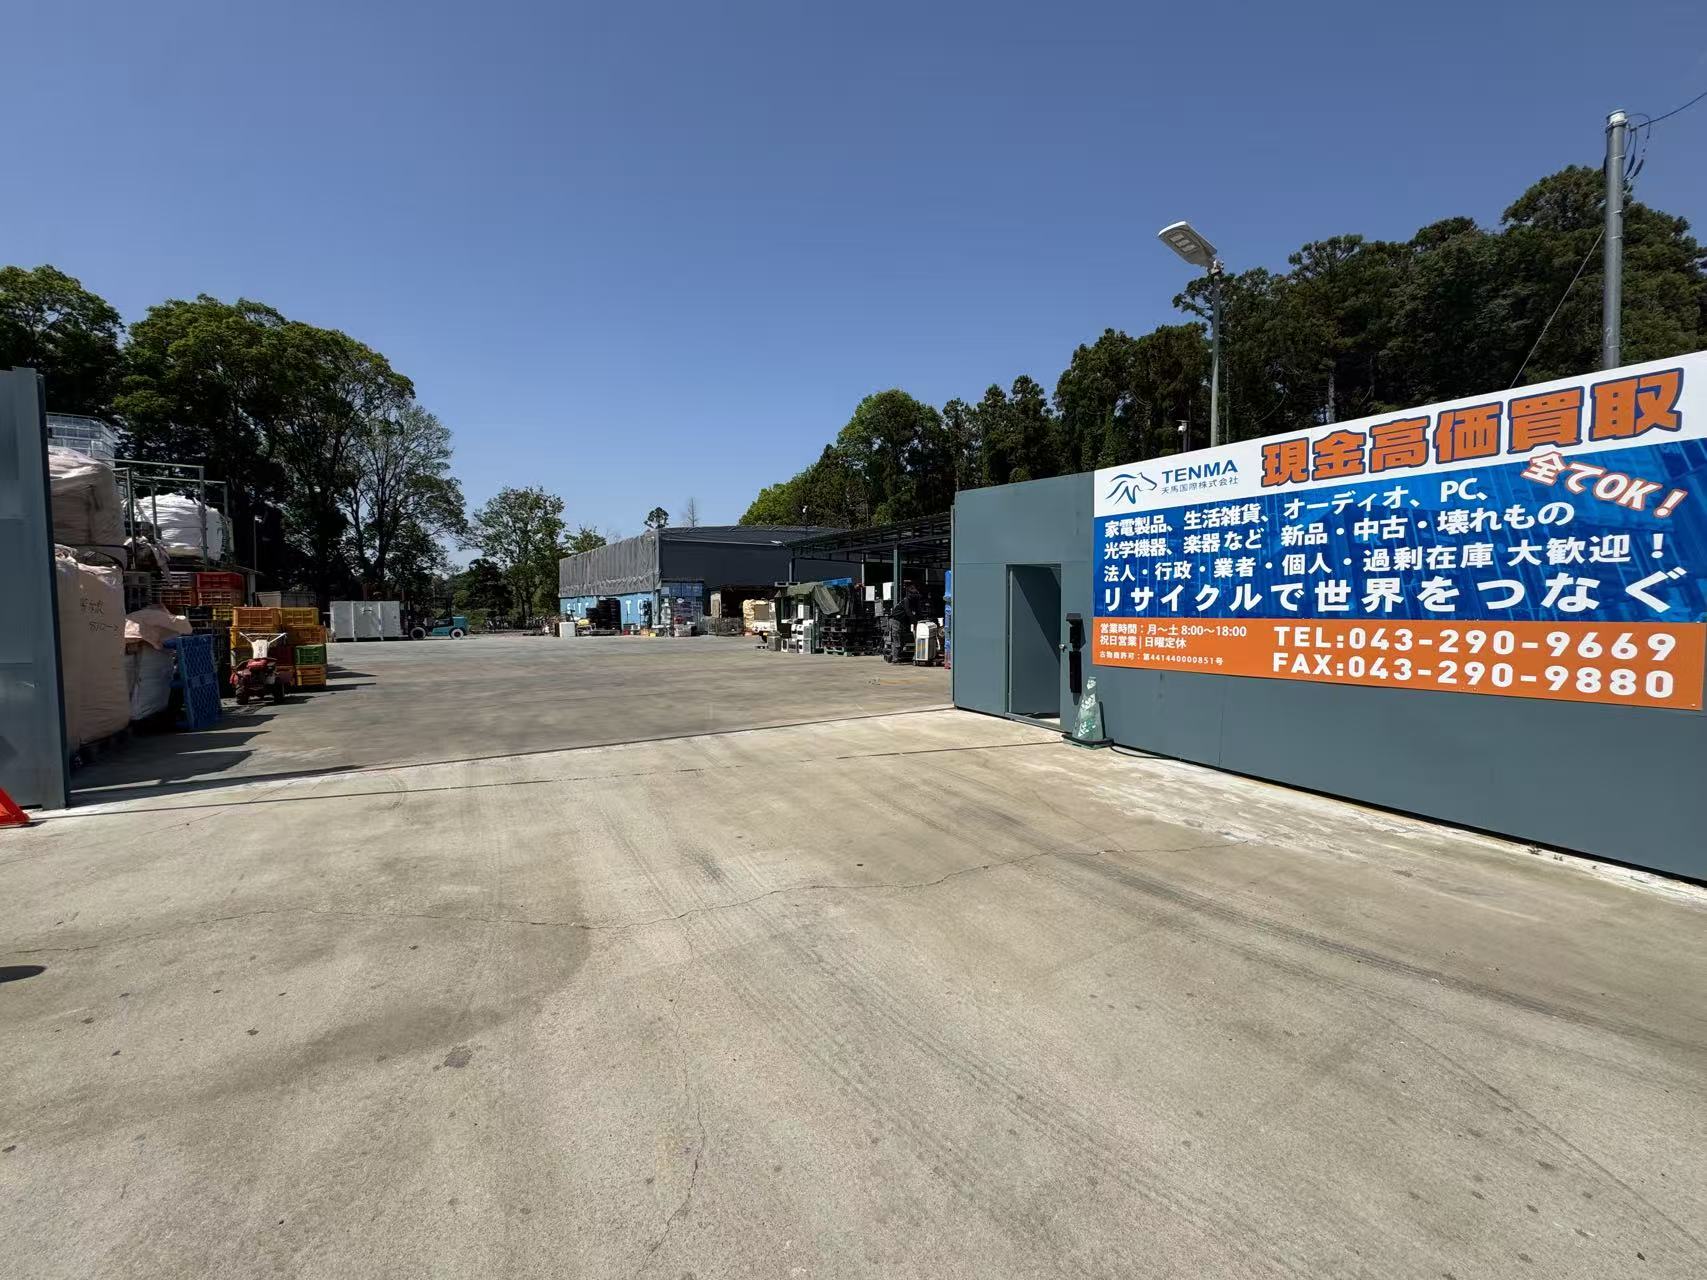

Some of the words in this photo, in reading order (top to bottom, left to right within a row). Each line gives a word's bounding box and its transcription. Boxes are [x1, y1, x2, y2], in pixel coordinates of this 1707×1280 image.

[1261, 367, 1684, 487] 現金高価買取
[1161, 459, 1238, 484] TENMA
[1161, 475, 1239, 495] 天馬国際株式会社
[1104, 566, 1687, 613] リサイクルで世界をつなぐ
[1273, 626, 1676, 661] TEL:043-290-9669
[1272, 652, 1674, 699] FAX:043-290-9880
